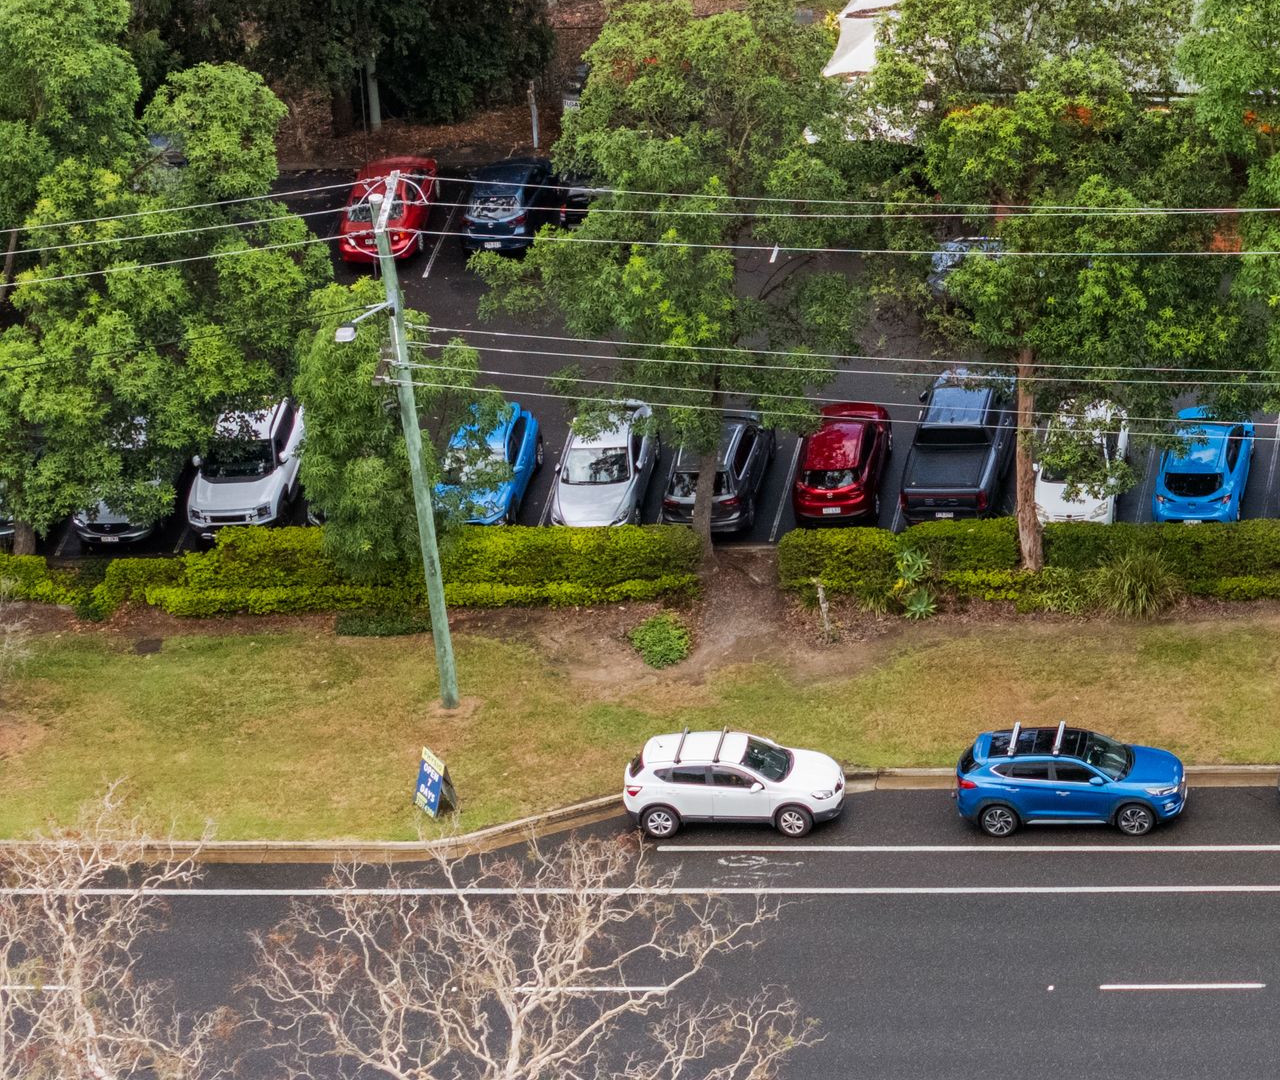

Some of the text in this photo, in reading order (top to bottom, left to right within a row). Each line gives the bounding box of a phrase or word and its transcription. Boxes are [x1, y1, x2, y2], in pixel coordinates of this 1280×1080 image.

[423, 763, 439, 782] OPEN
[427, 778, 432, 786] 7
[420, 784, 435, 802] DAYS
